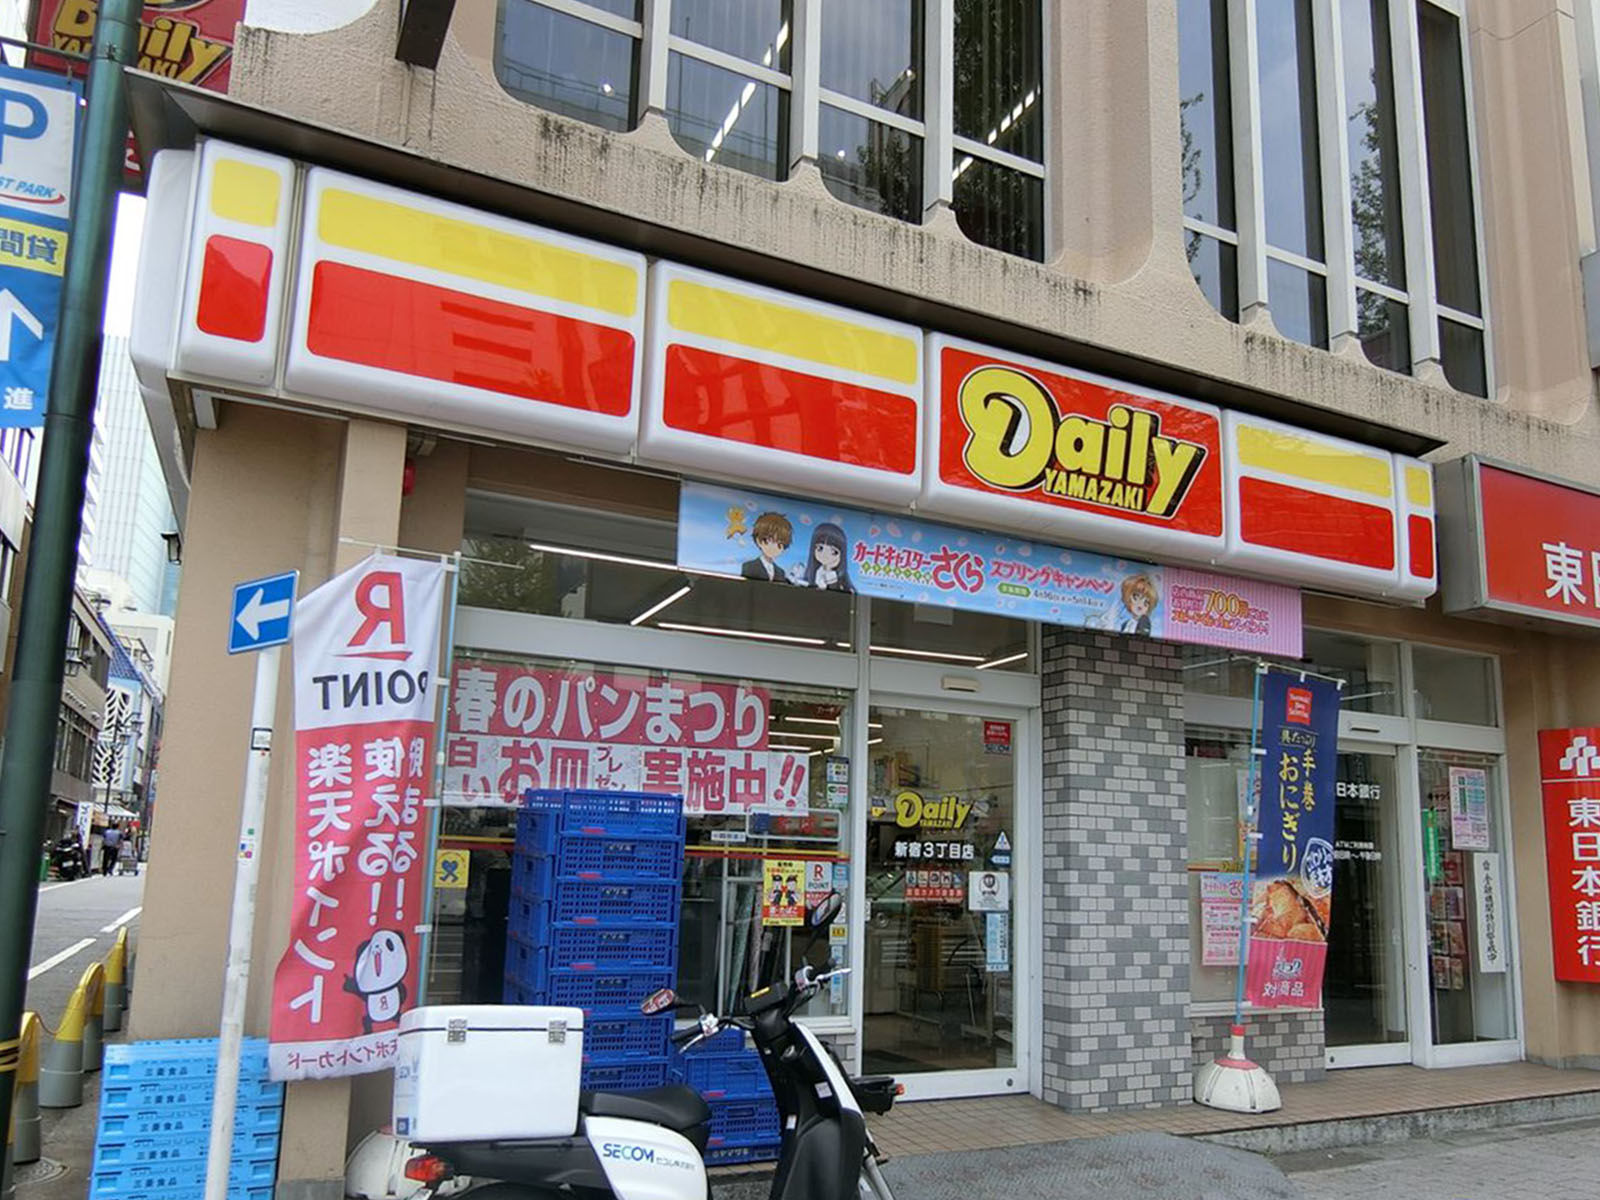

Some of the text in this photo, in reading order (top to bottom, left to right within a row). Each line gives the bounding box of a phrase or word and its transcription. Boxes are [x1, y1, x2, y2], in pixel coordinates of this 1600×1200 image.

[53, 0, 228, 86] Dily
[0, 88, 49, 164] P
[15, 179, 56, 199] PARK
[3, 386, 34, 411] 進
[960, 367, 1203, 517] Daily
[1043, 467, 1149, 511] YAMAZAKI
[1541, 541, 1600, 609] 東
[454, 667, 766, 748] 春のパンまつり
[1302, 748, 1317, 811] 手巻
[894, 791, 973, 829] Daily
[1278, 751, 1301, 873] おにぎり
[813, 863, 824, 878] R
[894, 841, 976, 860] 新宿3丁目店
[1567, 797, 1600, 967] 東日本銀行
[1262, 981, 1304, 999] 対商品
[602, 1143, 654, 1163] SECOM
